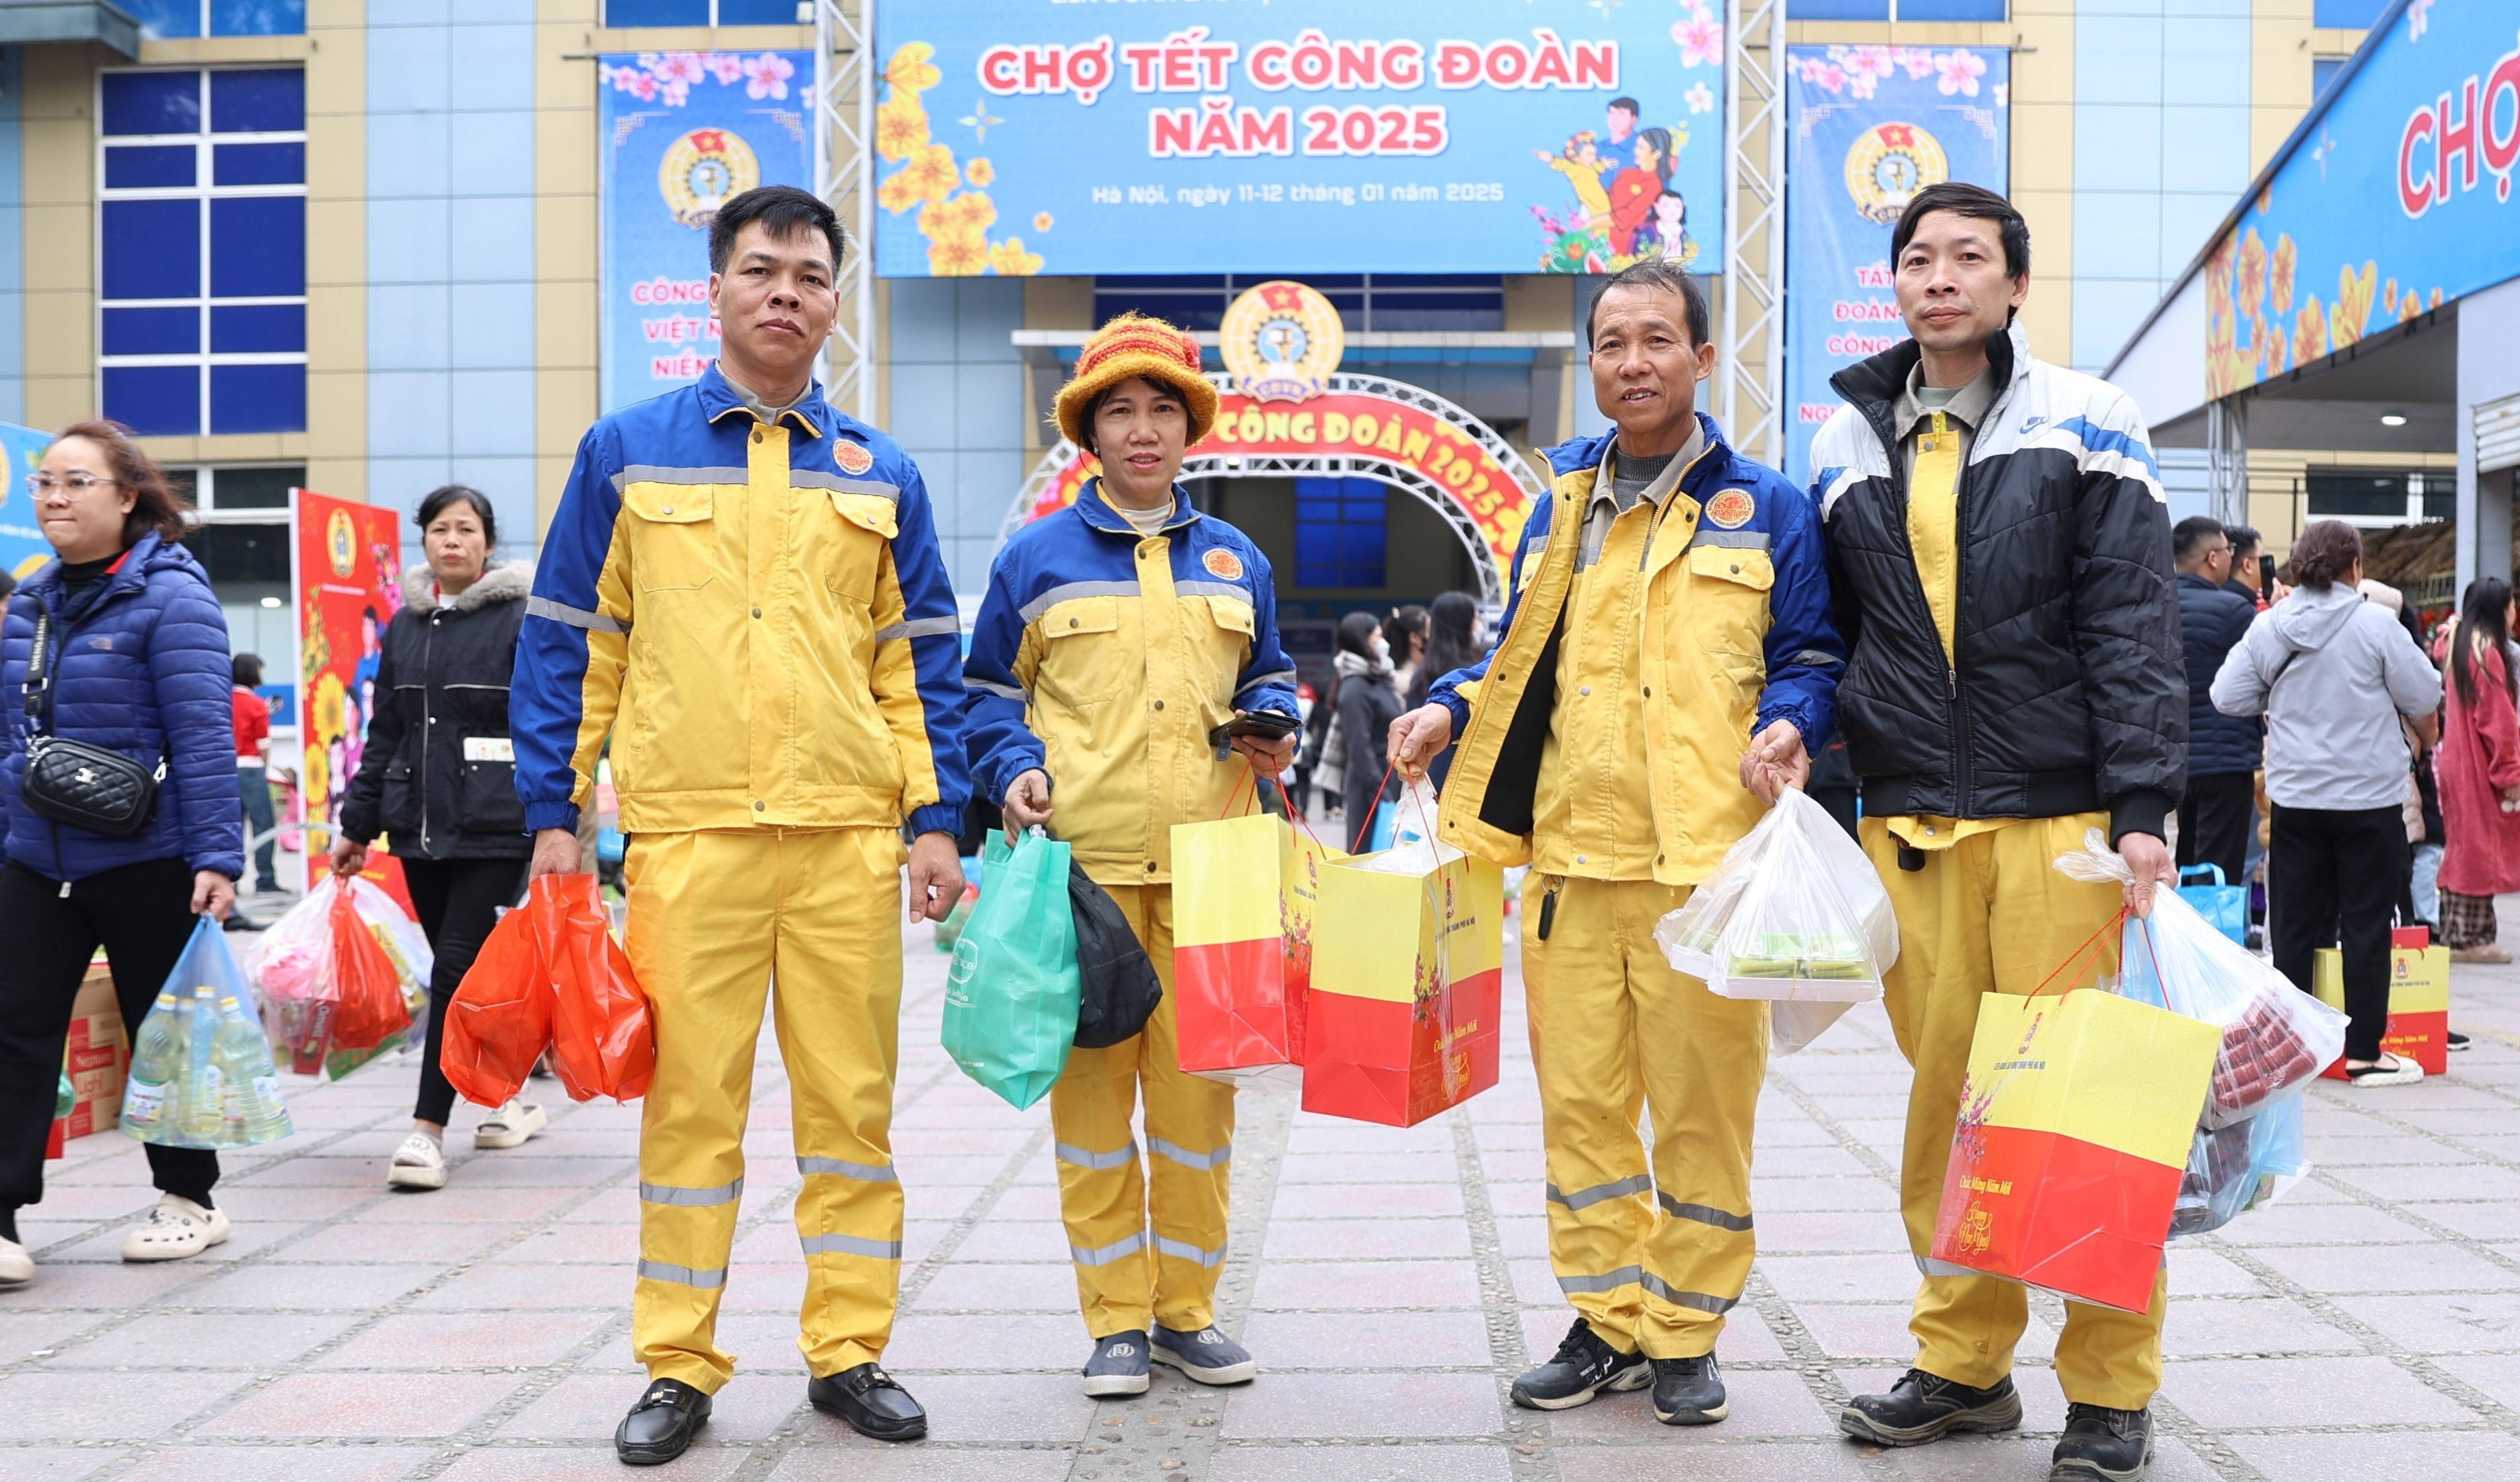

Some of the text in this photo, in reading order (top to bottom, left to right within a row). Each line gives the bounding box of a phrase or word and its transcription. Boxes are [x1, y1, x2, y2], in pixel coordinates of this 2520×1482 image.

[981, 30, 1615, 102] CHỢ TẾT CÔNG ĐOÀN
[1152, 98, 1445, 154] NĂM 2025
[1091, 184, 1123, 205] Hà
[1177, 184, 1232, 208] ngày
[1238, 184, 1284, 203] 11-12
[1290, 182, 1356, 206] tháng
[1360, 183, 1385, 202] 01
[1391, 183, 1440, 202] năm
[1445, 182, 1505, 202] 2025
[633, 278, 707, 302] CÔNG
[1834, 297, 1898, 321] ĐOÀN
[1828, 332, 1891, 355] CÔNG
[1216, 403, 1506, 518] CÔNG ĐOÀN 2025
